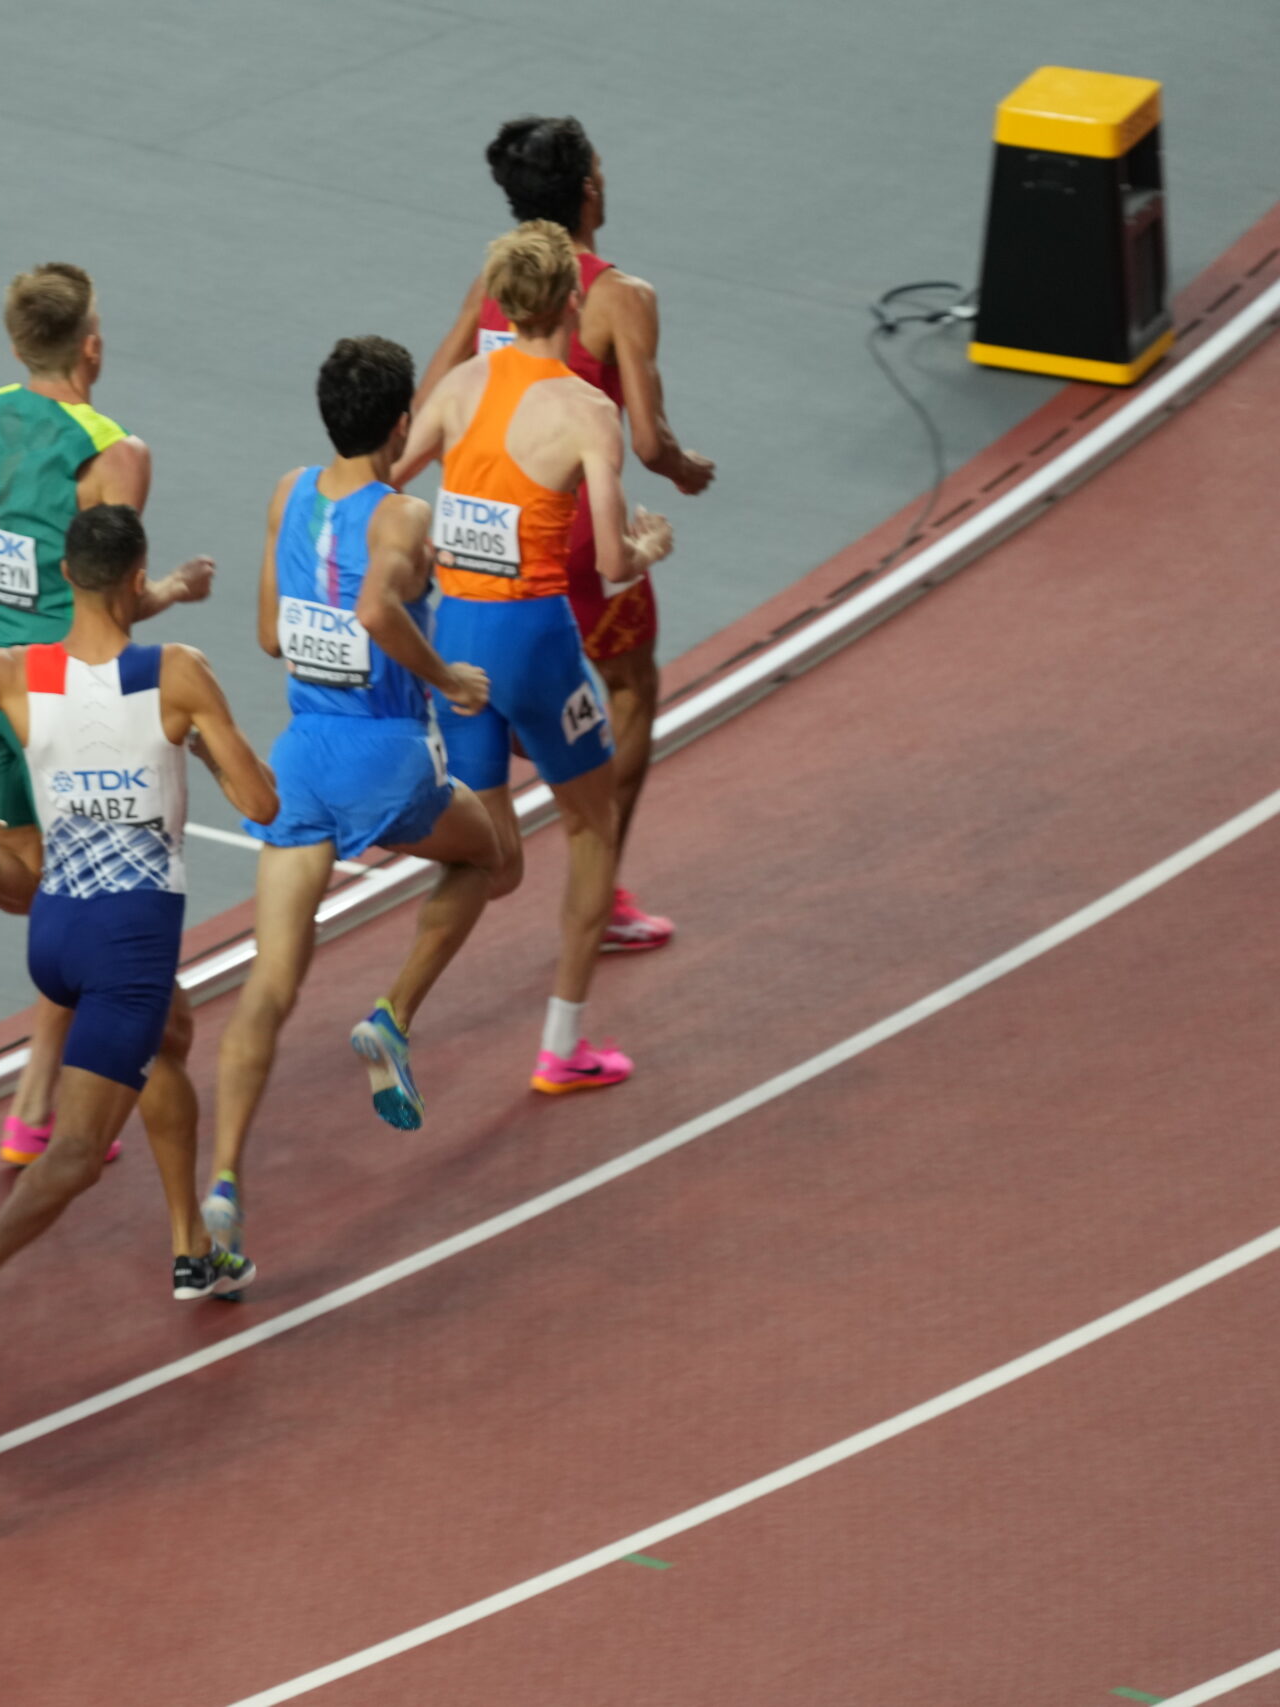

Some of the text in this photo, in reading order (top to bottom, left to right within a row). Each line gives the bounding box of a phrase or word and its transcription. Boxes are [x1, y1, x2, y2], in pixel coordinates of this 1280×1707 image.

[456, 499, 510, 530] TDK
[442, 522, 506, 556] LAROS
[303, 604, 358, 637] TDK
[287, 632, 352, 667] ARESE
[566, 693, 595, 732] 14
[72, 767, 150, 792] TDK
[69, 796, 138, 822] HABZ
